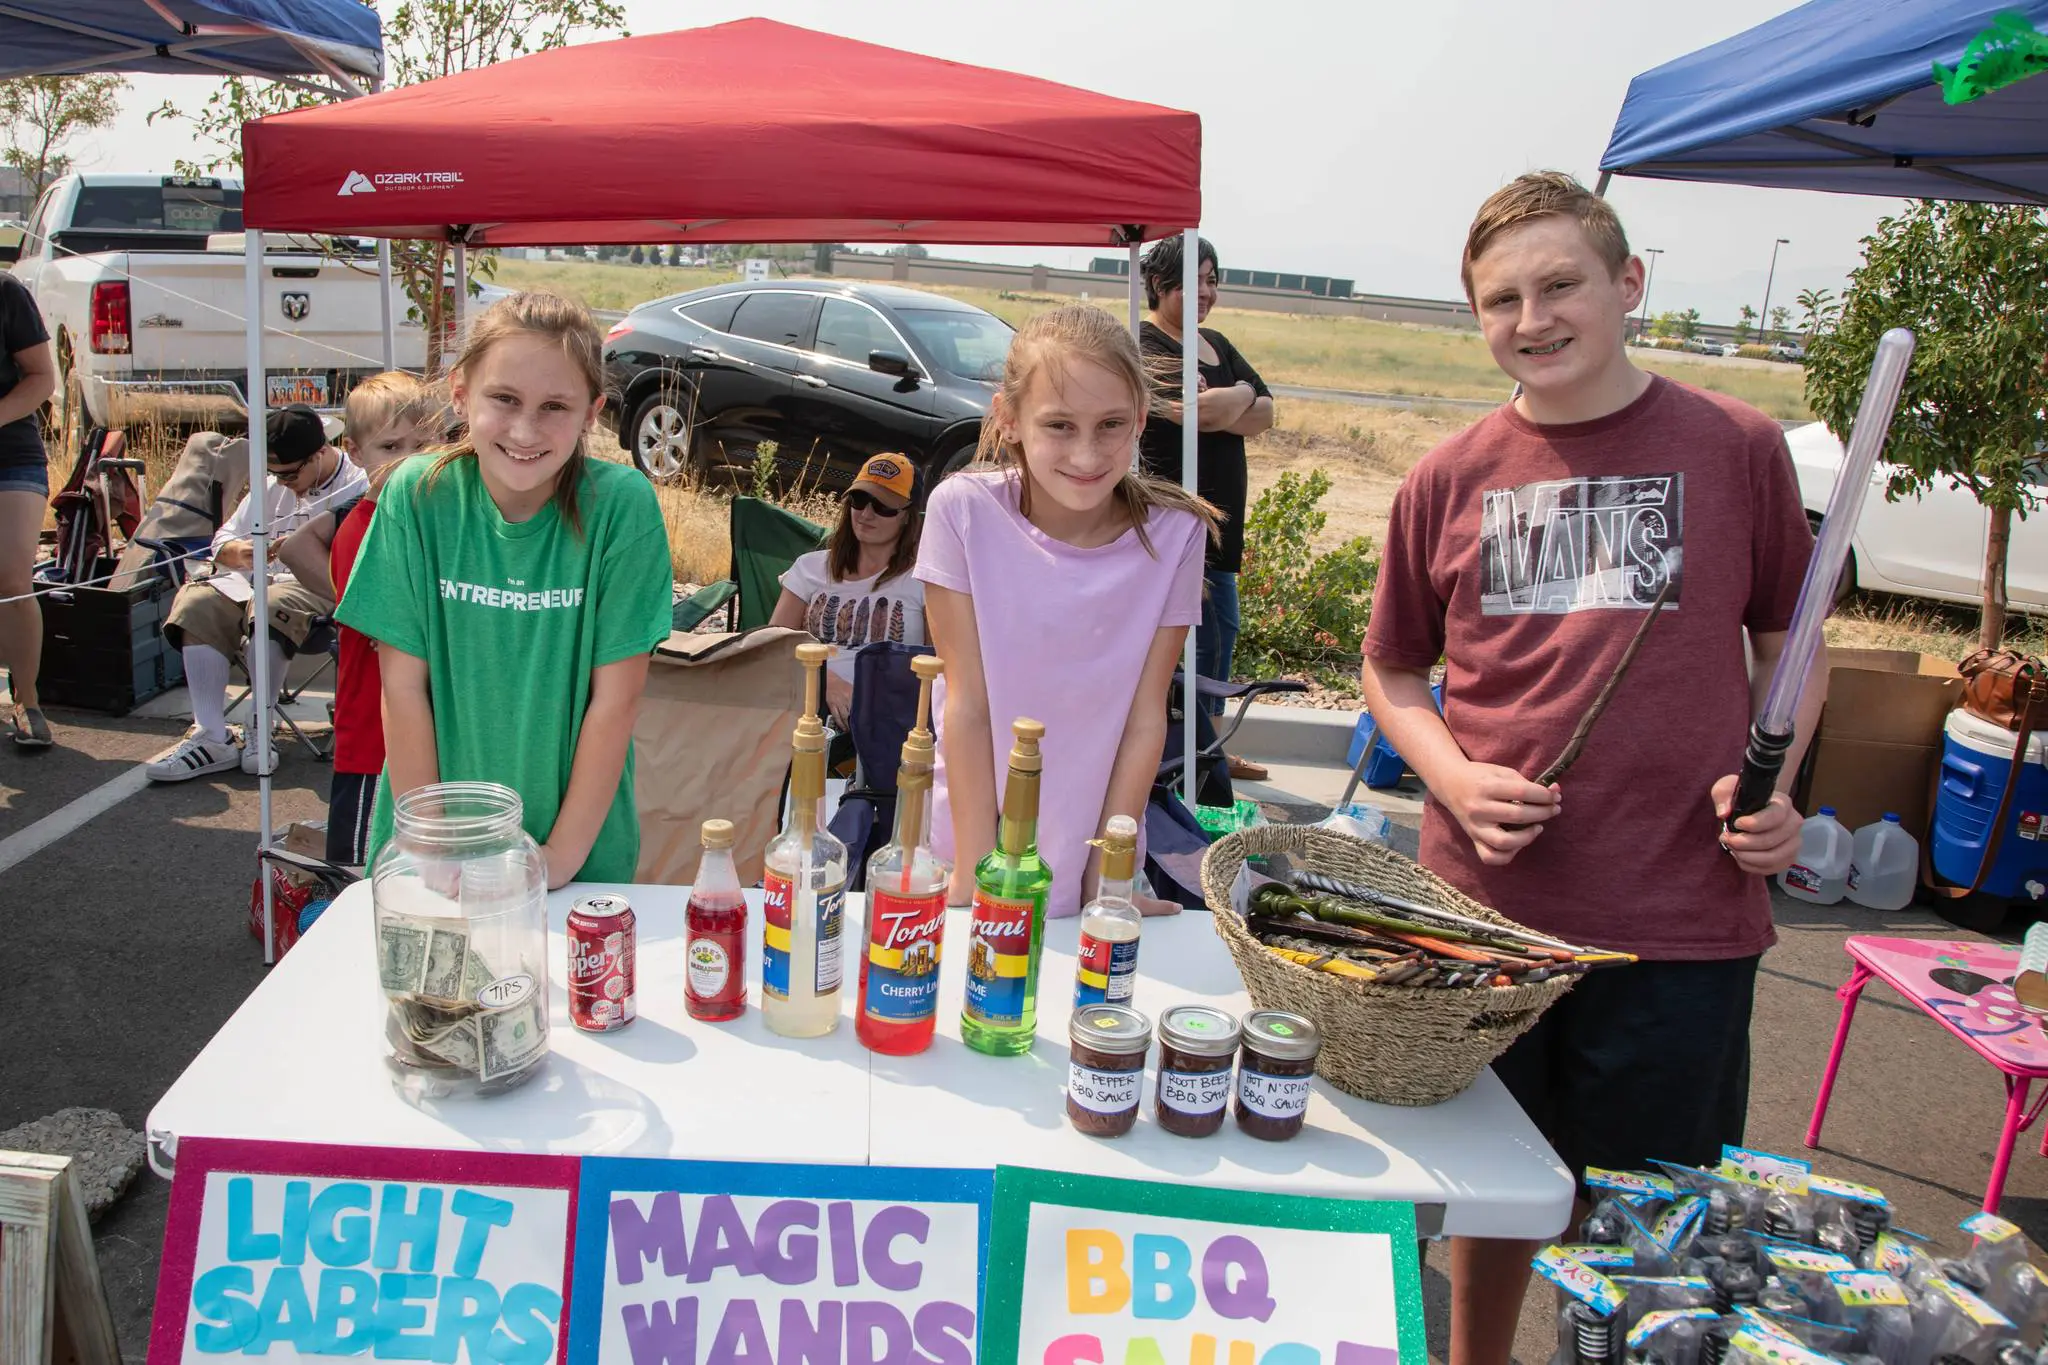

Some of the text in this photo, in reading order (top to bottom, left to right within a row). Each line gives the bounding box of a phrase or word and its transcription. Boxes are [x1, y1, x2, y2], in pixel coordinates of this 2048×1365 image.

[375, 171, 464, 184] OZARK TRAIL
[1493, 478, 1671, 608] VANS
[568, 937, 591, 957] Dr
[489, 981, 522, 1000] TIPS
[881, 983, 923, 998] CHERRY
[1073, 1080, 1133, 1102] BBQ SAUCE
[1092, 1074, 1135, 1088] PEPPER
[1169, 1073, 1197, 1088] ROOT
[1247, 1074, 1263, 1087] HOT
[1167, 1086, 1197, 1104] BBQ
[1243, 1086, 1306, 1109] BBQ SAUCE
[227, 1177, 514, 1278] LIGHT
[609, 1191, 930, 1291] MAGIC
[1066, 1229, 1277, 1323] BBQ
[1555, 1258, 1604, 1294] TOYS
[193, 1265, 563, 1365] SABERS
[621, 1296, 975, 1365] WANDS
